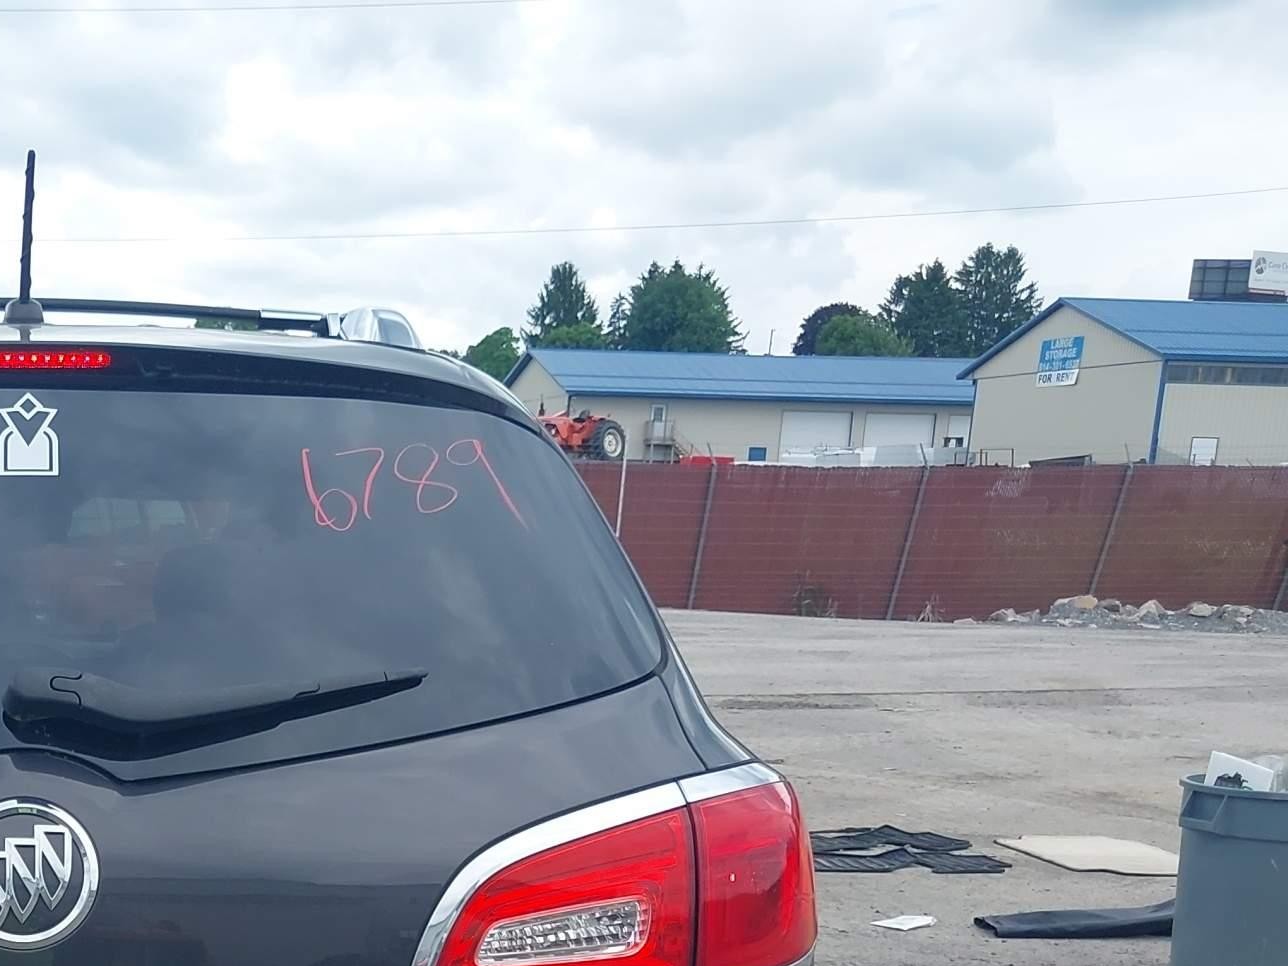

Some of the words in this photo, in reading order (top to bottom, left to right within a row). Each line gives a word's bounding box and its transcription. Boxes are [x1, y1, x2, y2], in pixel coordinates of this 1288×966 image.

[1045, 347, 1078, 360] STORAGE
[1038, 373, 1053, 384] FOR
[1056, 372, 1076, 383] RENT
[302, 439, 530, 532] 6789
